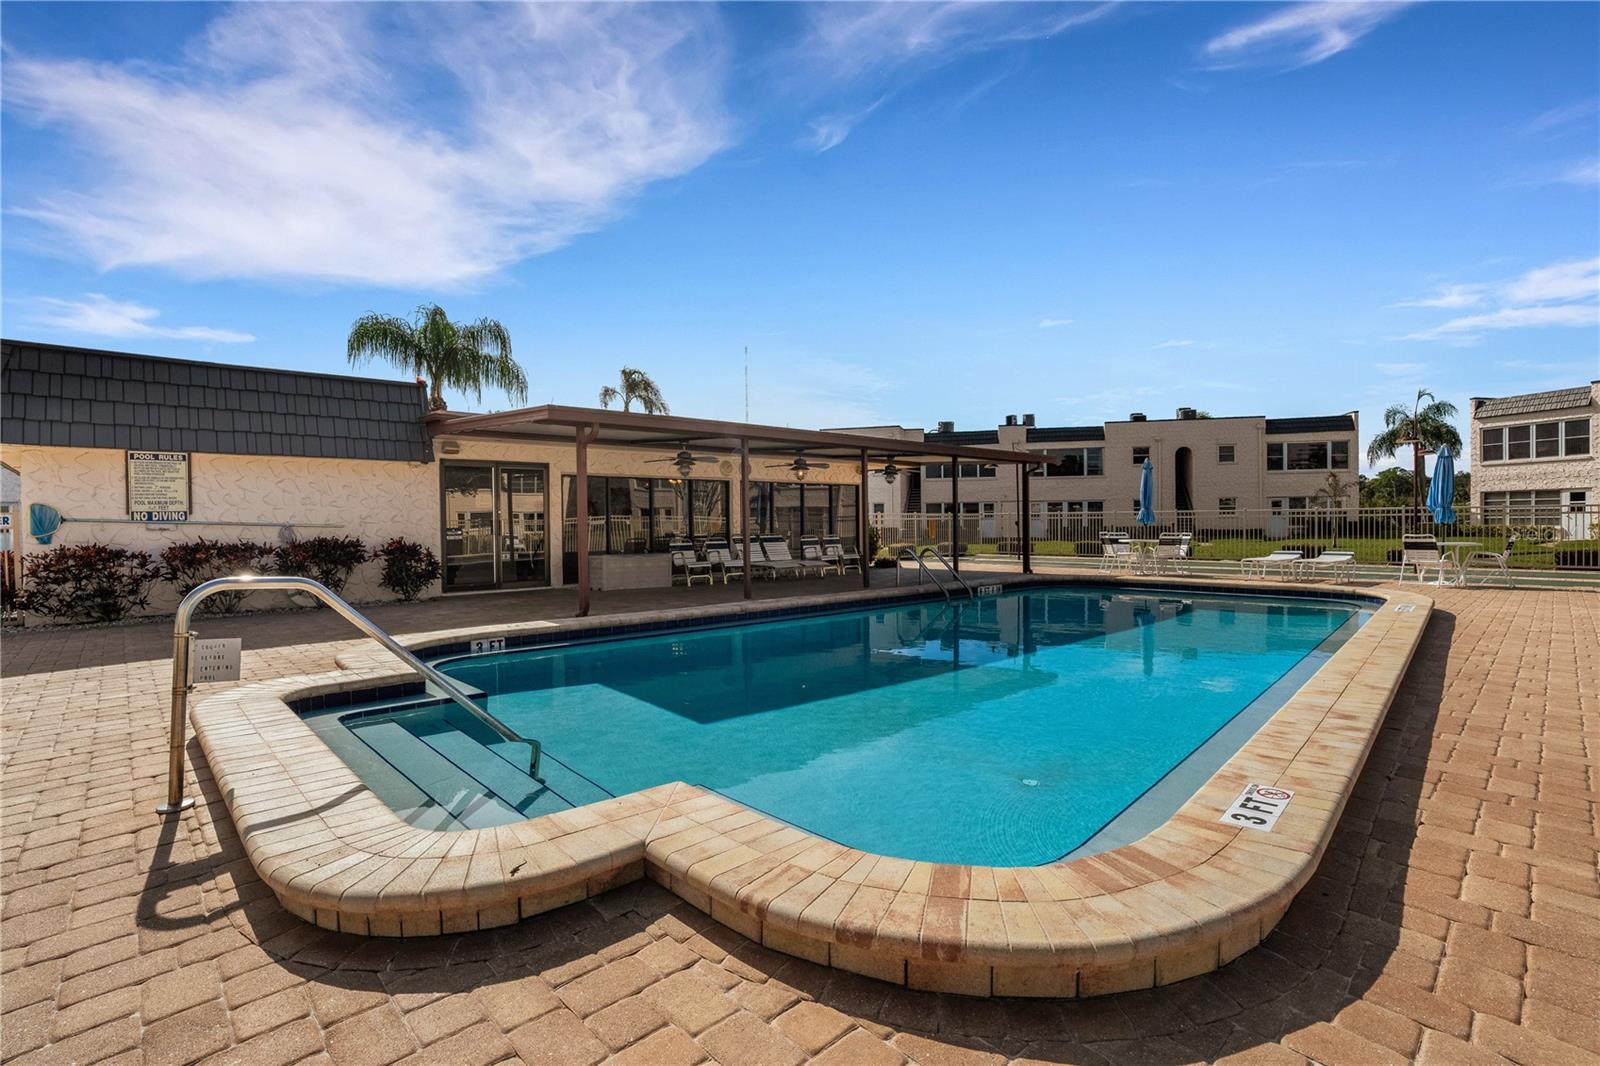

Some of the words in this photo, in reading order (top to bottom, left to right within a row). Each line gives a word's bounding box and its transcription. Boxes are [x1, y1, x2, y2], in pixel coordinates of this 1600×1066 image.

[133, 511, 148, 521] NO
[152, 511, 185, 521] DIVING
[1239, 796, 1278, 814] FT
[1231, 813, 1267, 825] 3
